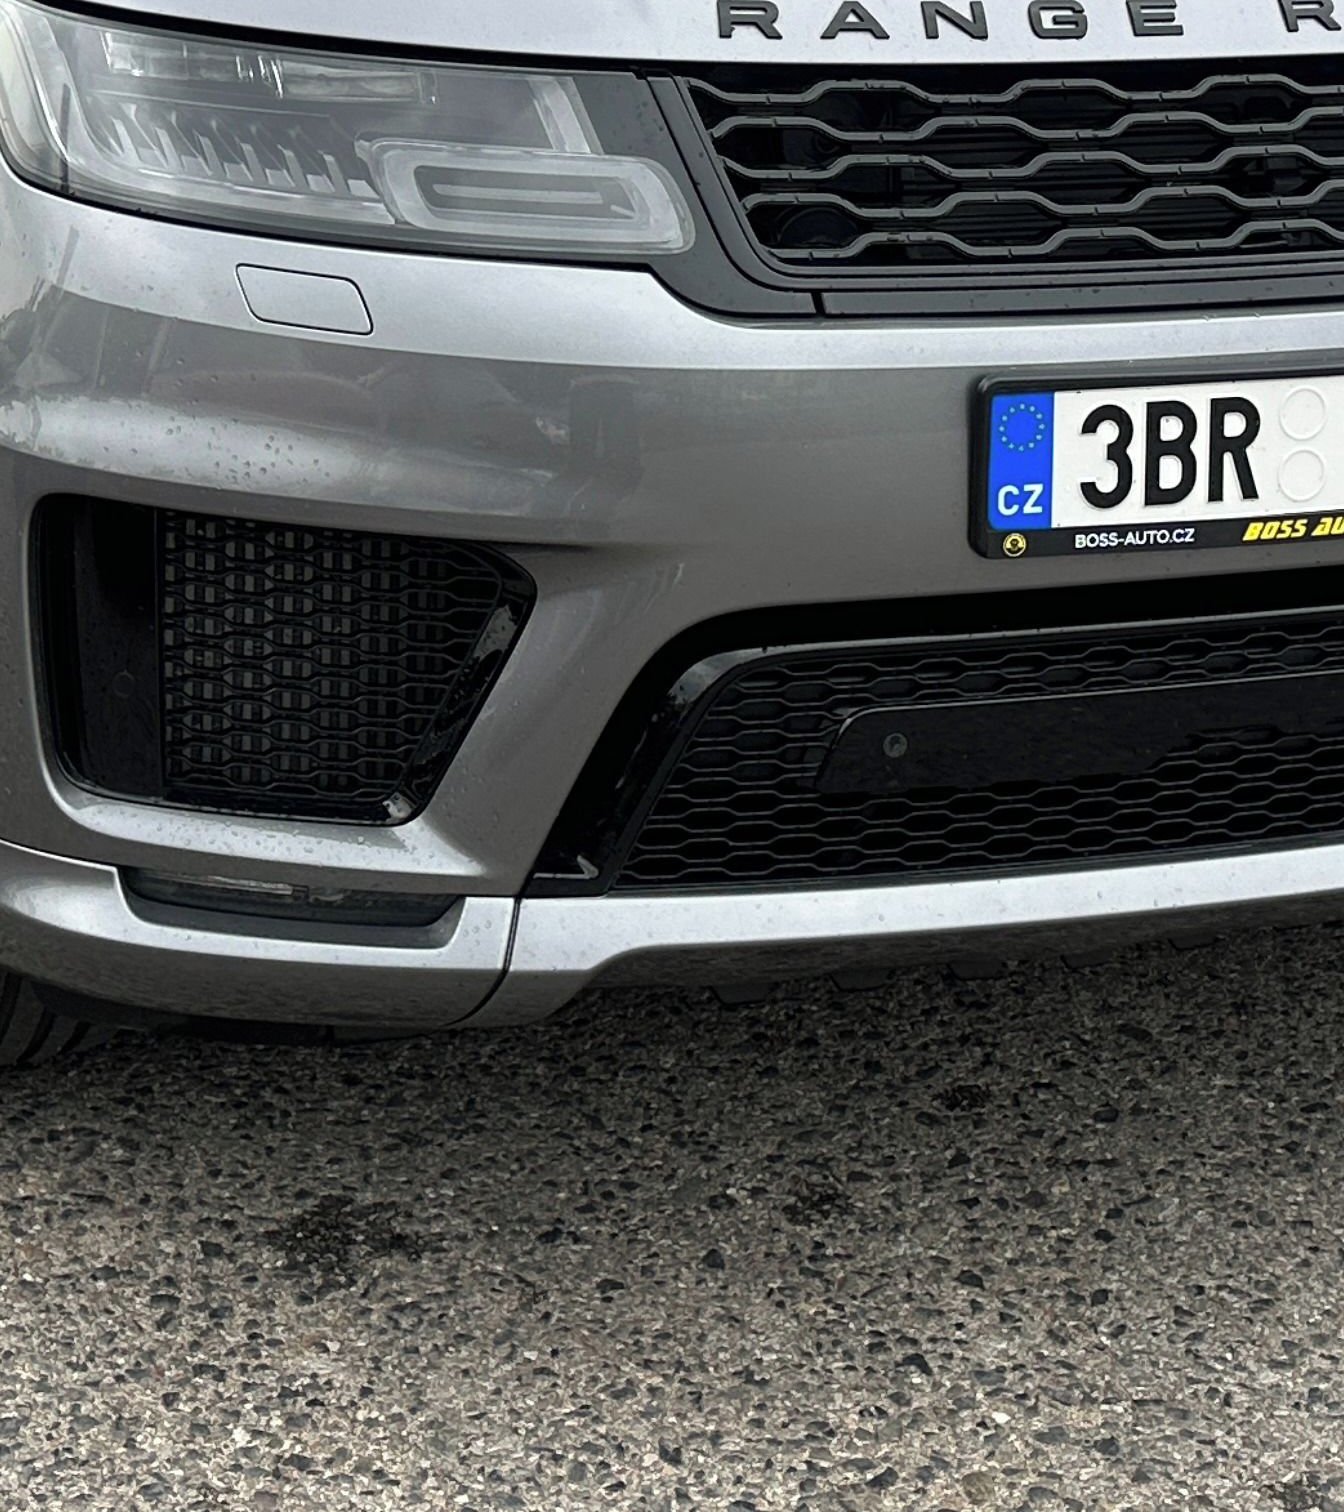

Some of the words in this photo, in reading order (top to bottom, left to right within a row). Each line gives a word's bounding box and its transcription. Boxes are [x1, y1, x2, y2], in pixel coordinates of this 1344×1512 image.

[1079, 396, 1262, 510] 3BR
[997, 483, 1043, 517] CZ
[1075, 528, 1195, 549] BOSS-AUTO.CZ
[1242, 518, 1308, 542] BOSS
